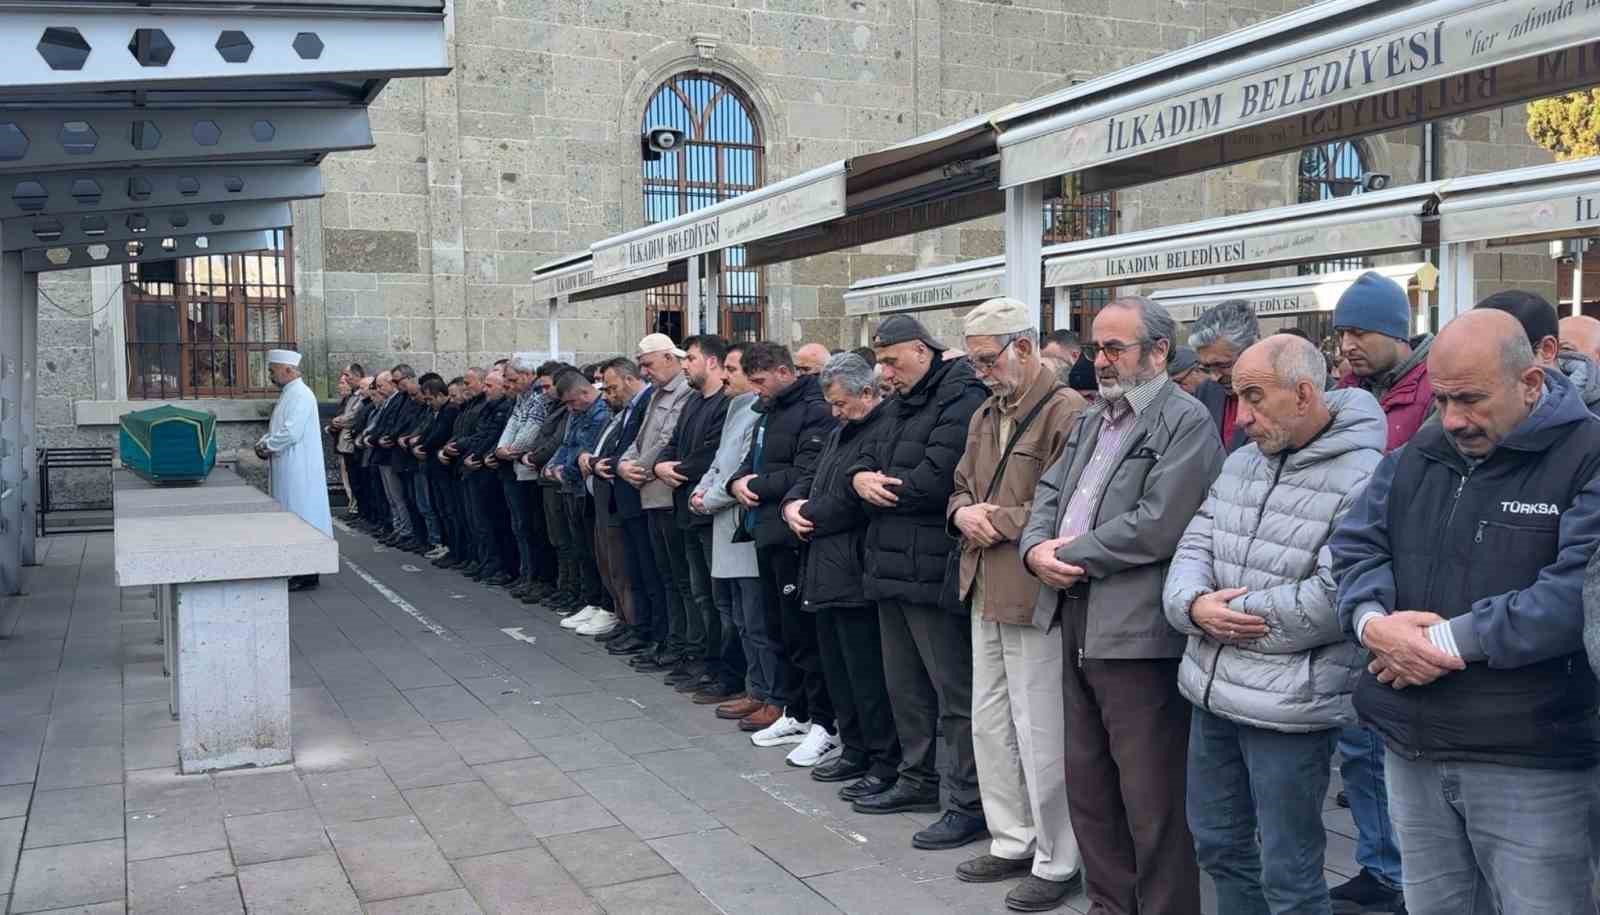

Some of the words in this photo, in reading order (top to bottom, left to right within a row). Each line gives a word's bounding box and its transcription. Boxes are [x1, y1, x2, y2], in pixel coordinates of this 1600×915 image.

[1106, 93, 1224, 153] İLKADIM
[1240, 20, 1446, 118] BELEDİYESİ
[630, 238, 664, 265] İLKADIM
[668, 216, 720, 256] BELEDİYESİ
[1106, 254, 1159, 277] İLKADIM
[1167, 240, 1246, 269] BELEDİYESİ
